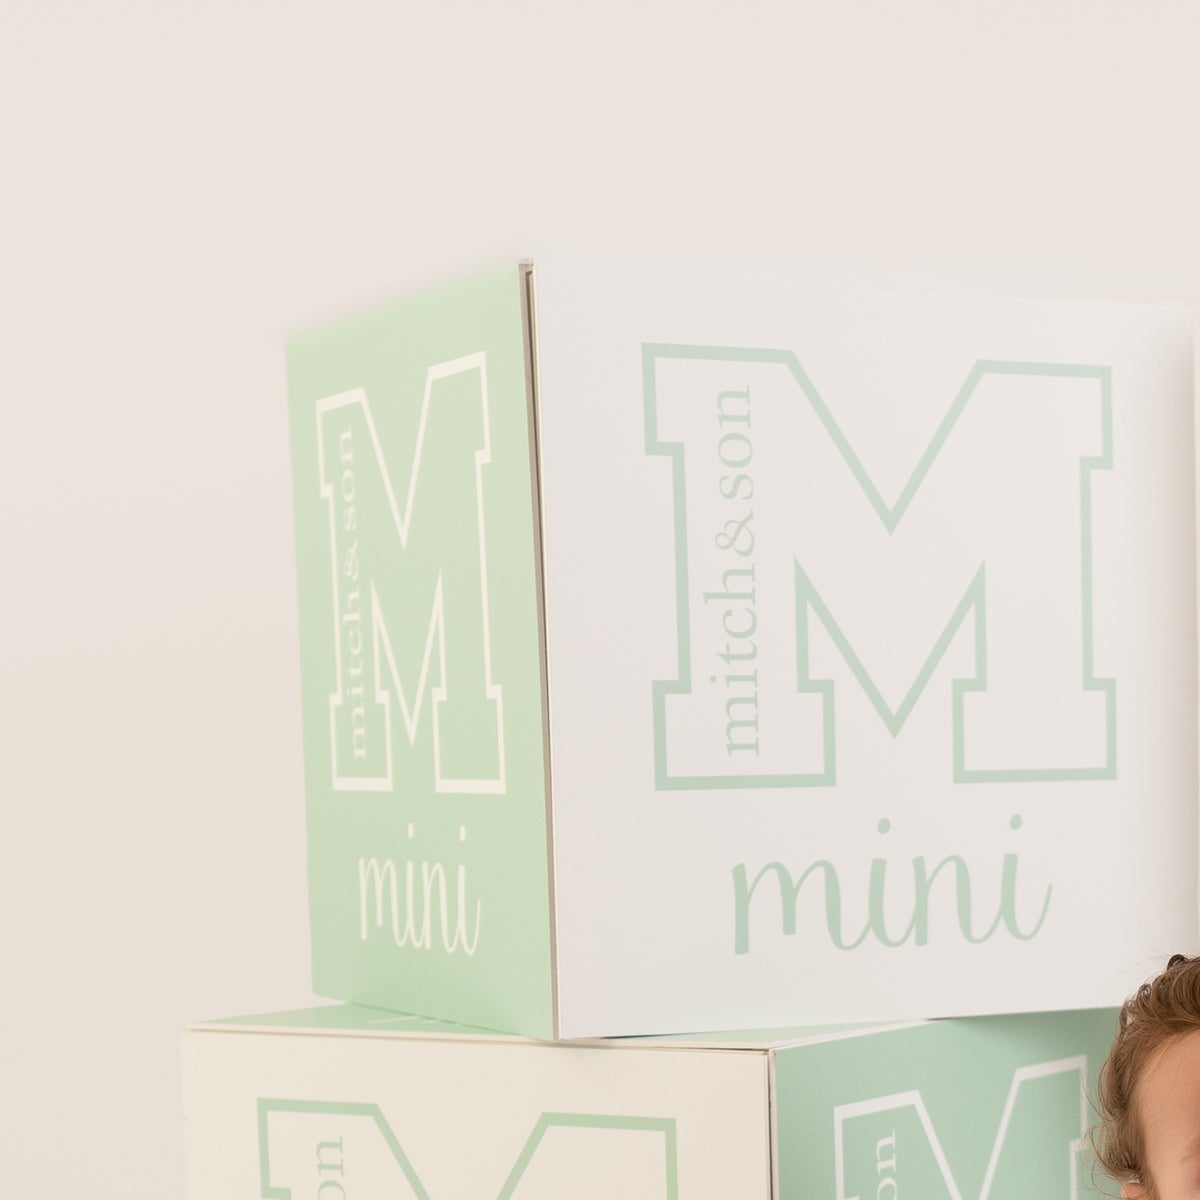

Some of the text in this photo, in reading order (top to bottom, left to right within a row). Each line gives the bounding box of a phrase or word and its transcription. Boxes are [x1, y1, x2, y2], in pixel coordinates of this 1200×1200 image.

[315, 350, 507, 795] M
[339, 427, 367, 762] mitch&son
[641, 341, 1117, 791] M
[703, 384, 760, 758] mitch&son
[358, 821, 481, 956] mini
[730, 813, 1053, 956] mini
